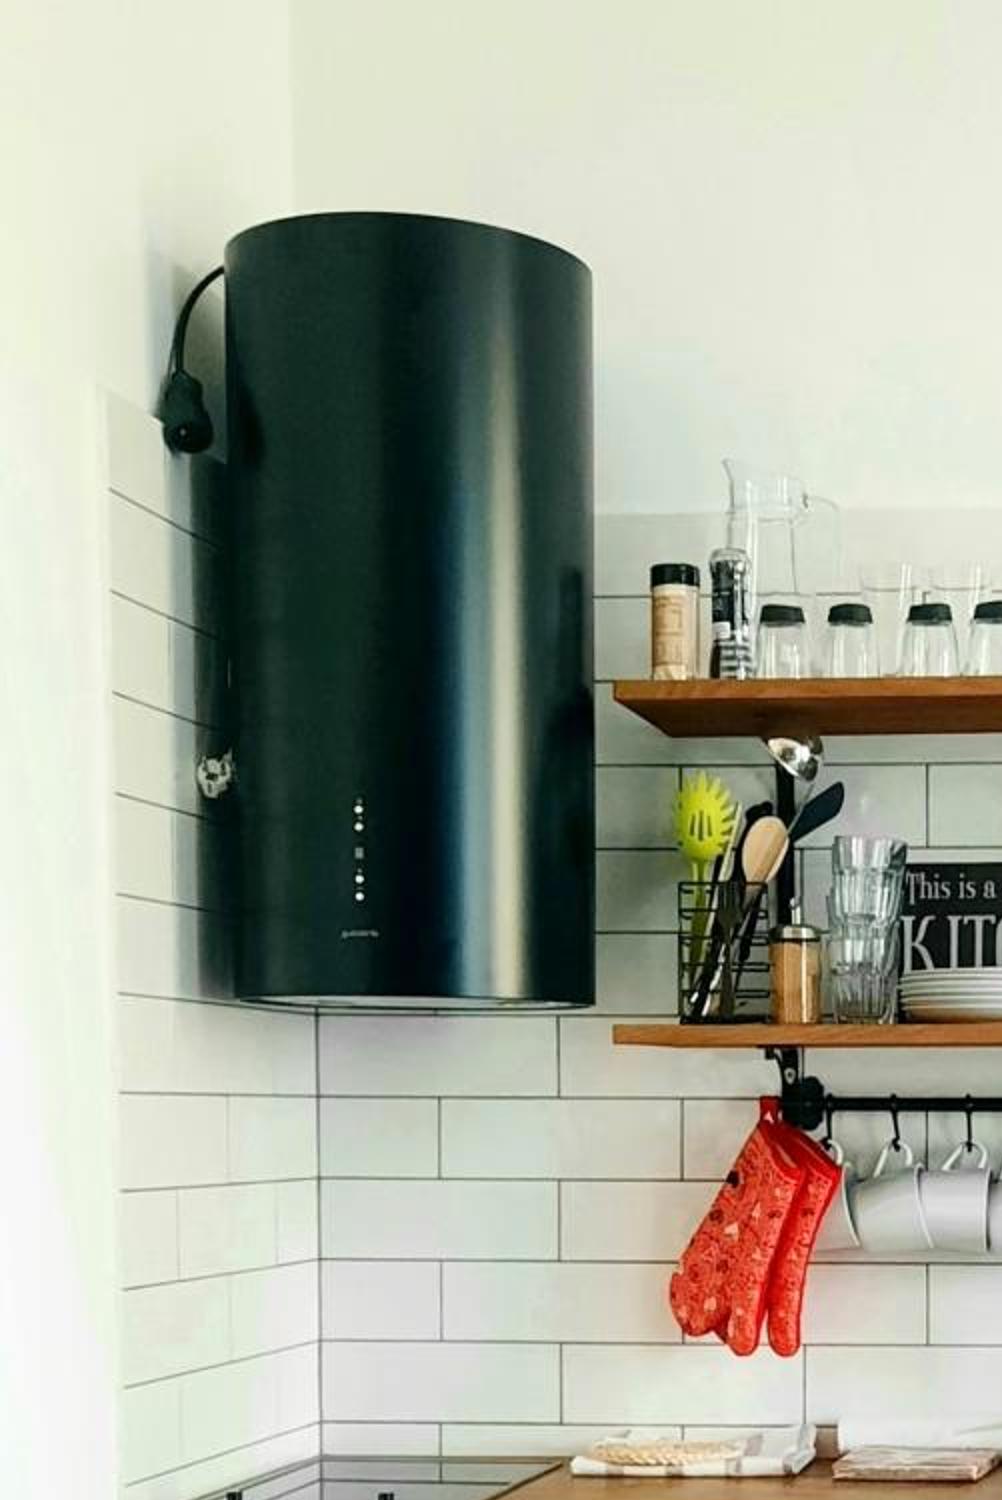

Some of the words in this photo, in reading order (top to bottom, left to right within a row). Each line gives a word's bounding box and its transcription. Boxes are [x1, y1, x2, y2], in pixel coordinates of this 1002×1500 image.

[906, 871, 951, 905] This
[959, 872, 977, 899] is
[983, 881, 997, 899] a
